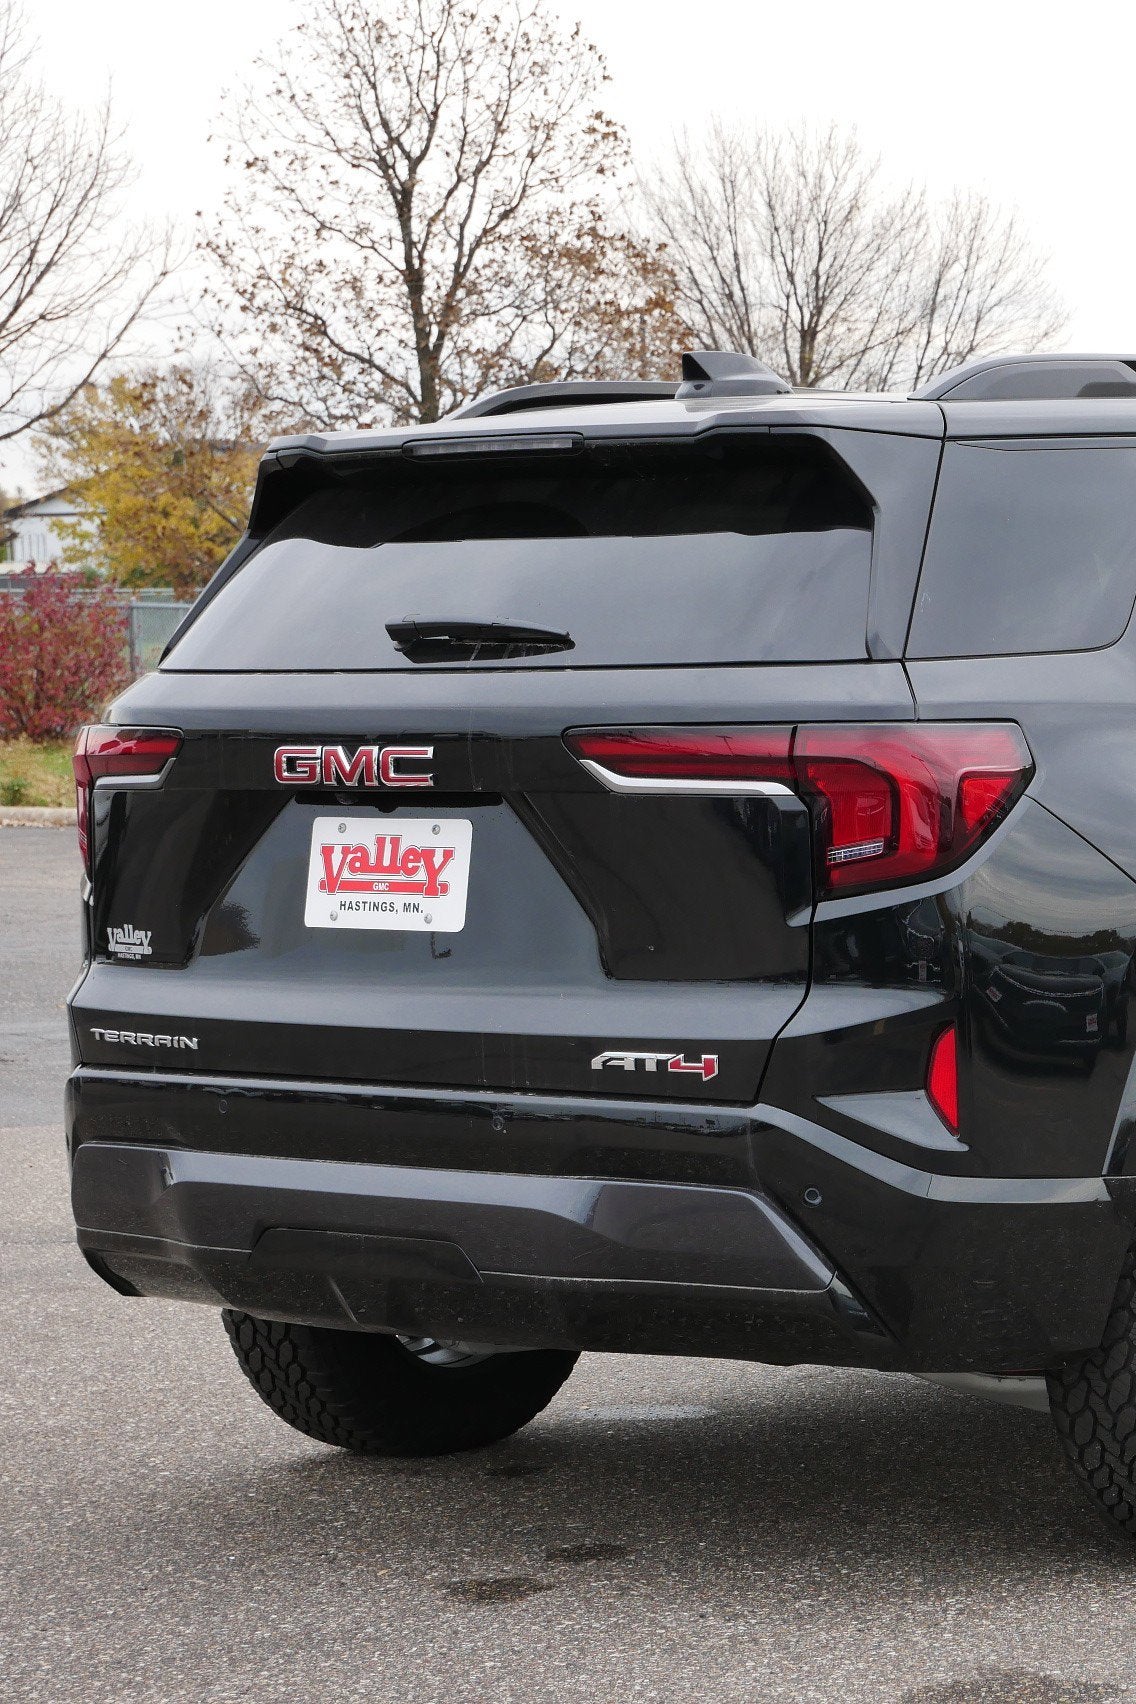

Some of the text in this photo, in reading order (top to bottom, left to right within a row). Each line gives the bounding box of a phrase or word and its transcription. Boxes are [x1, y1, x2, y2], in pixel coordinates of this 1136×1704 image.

[274, 745, 434, 786] GMC
[320, 834, 455, 897] Valley
[373, 882, 389, 891] GMC
[340, 900, 424, 914] HASTINGS, MN.
[90, 1027, 199, 1050] TERRAIN
[591, 1052, 718, 1081] AT4
